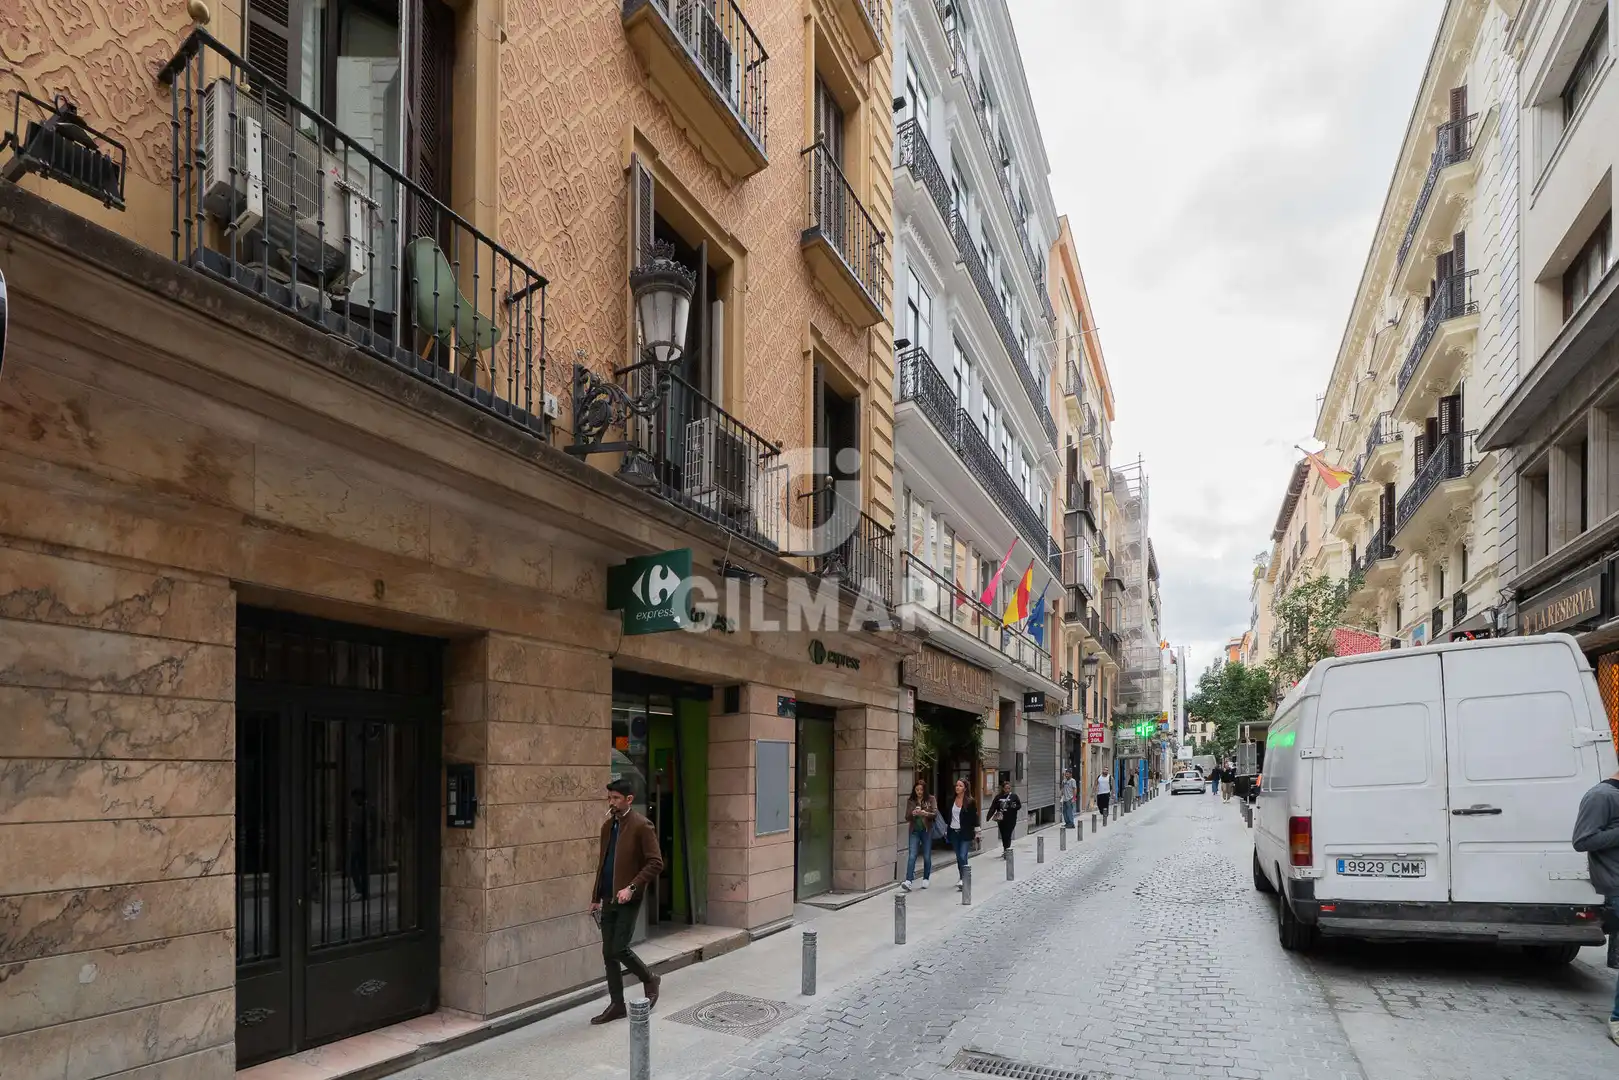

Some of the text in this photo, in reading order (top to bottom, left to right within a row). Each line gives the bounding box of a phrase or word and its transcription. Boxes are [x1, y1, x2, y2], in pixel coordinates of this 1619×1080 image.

[635, 606, 675, 621] express
[1547, 586, 1596, 627] RESERVA
[827, 650, 861, 671] express
[1348, 861, 1385, 872] 9929
[1391, 862, 1420, 874] CMM
